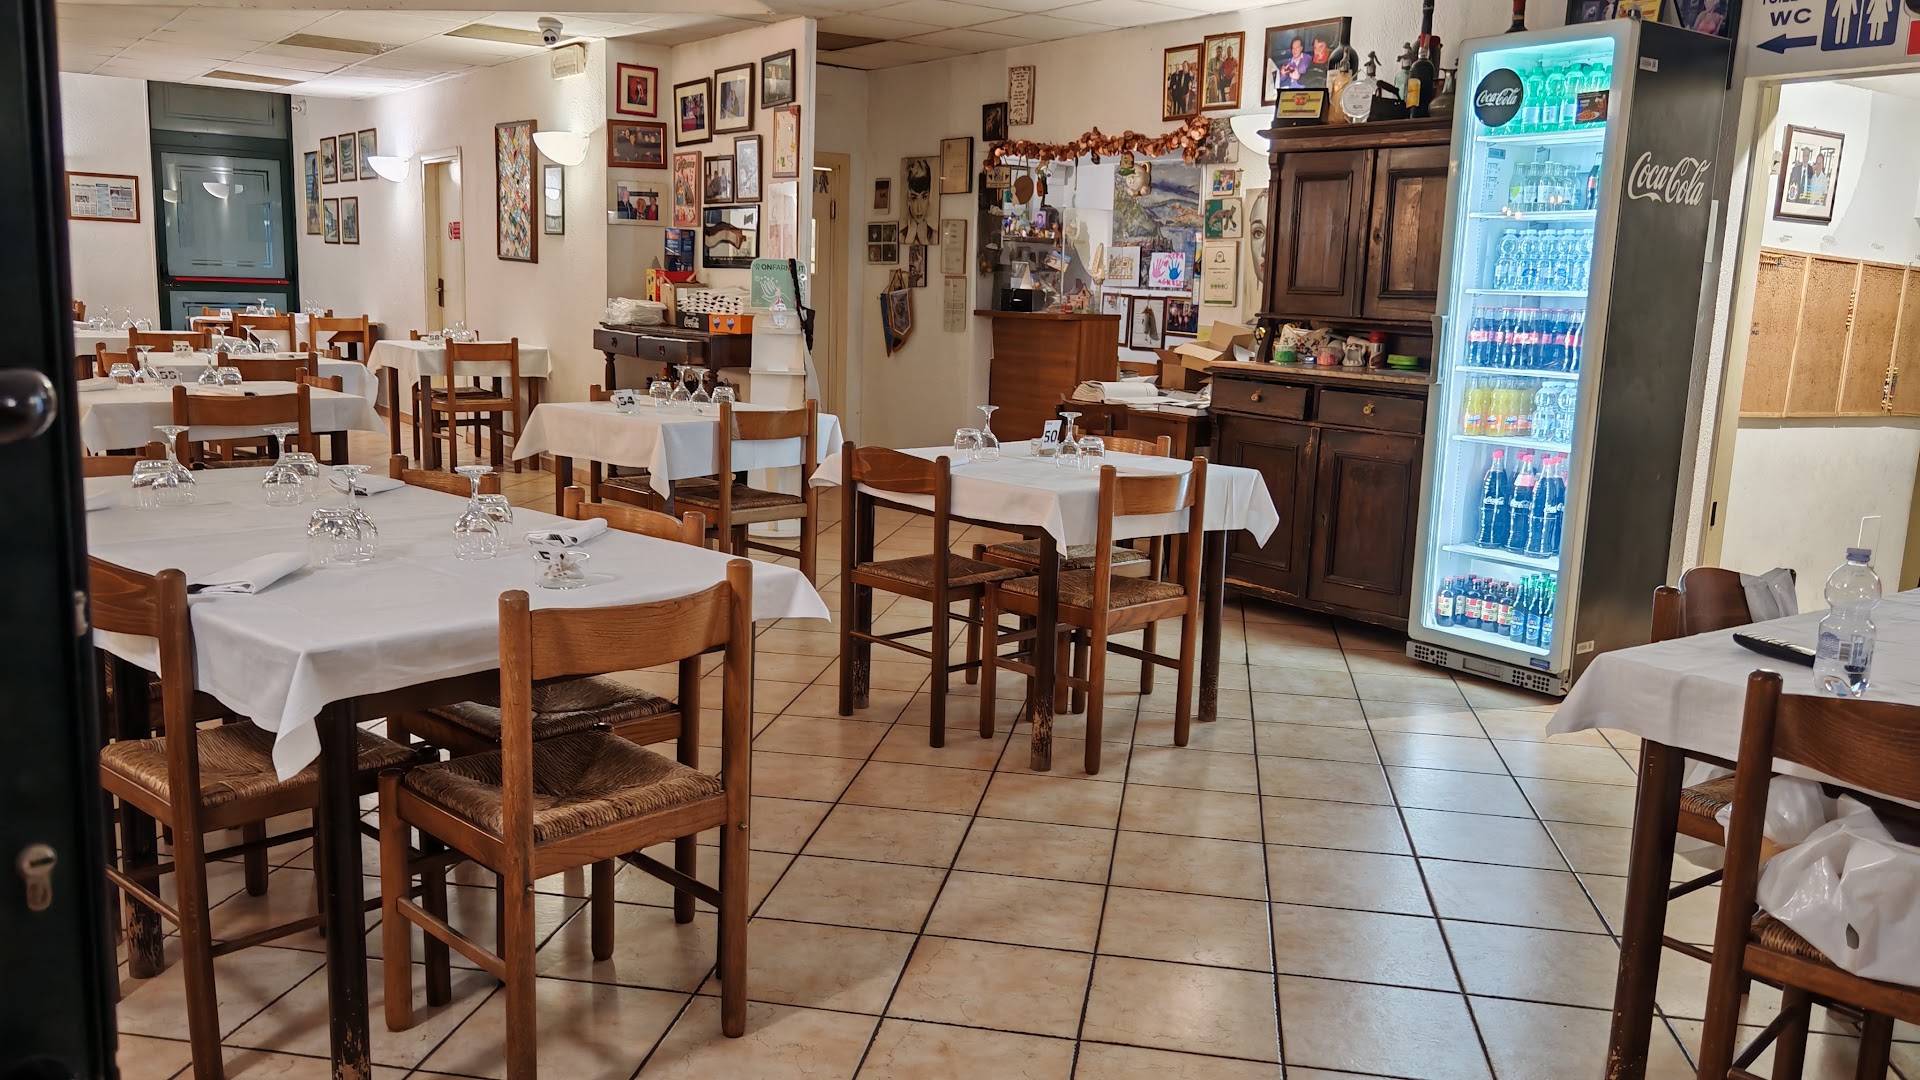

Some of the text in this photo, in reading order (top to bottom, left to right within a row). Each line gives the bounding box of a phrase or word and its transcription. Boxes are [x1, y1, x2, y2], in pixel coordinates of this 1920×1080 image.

[1770, 8, 1812, 27] WC
[1476, 87, 1521, 107] Coca-Cola
[1628, 151, 1712, 206] Coca-Cola
[618, 396, 635, 406] 54
[1043, 429, 1058, 443] 50
